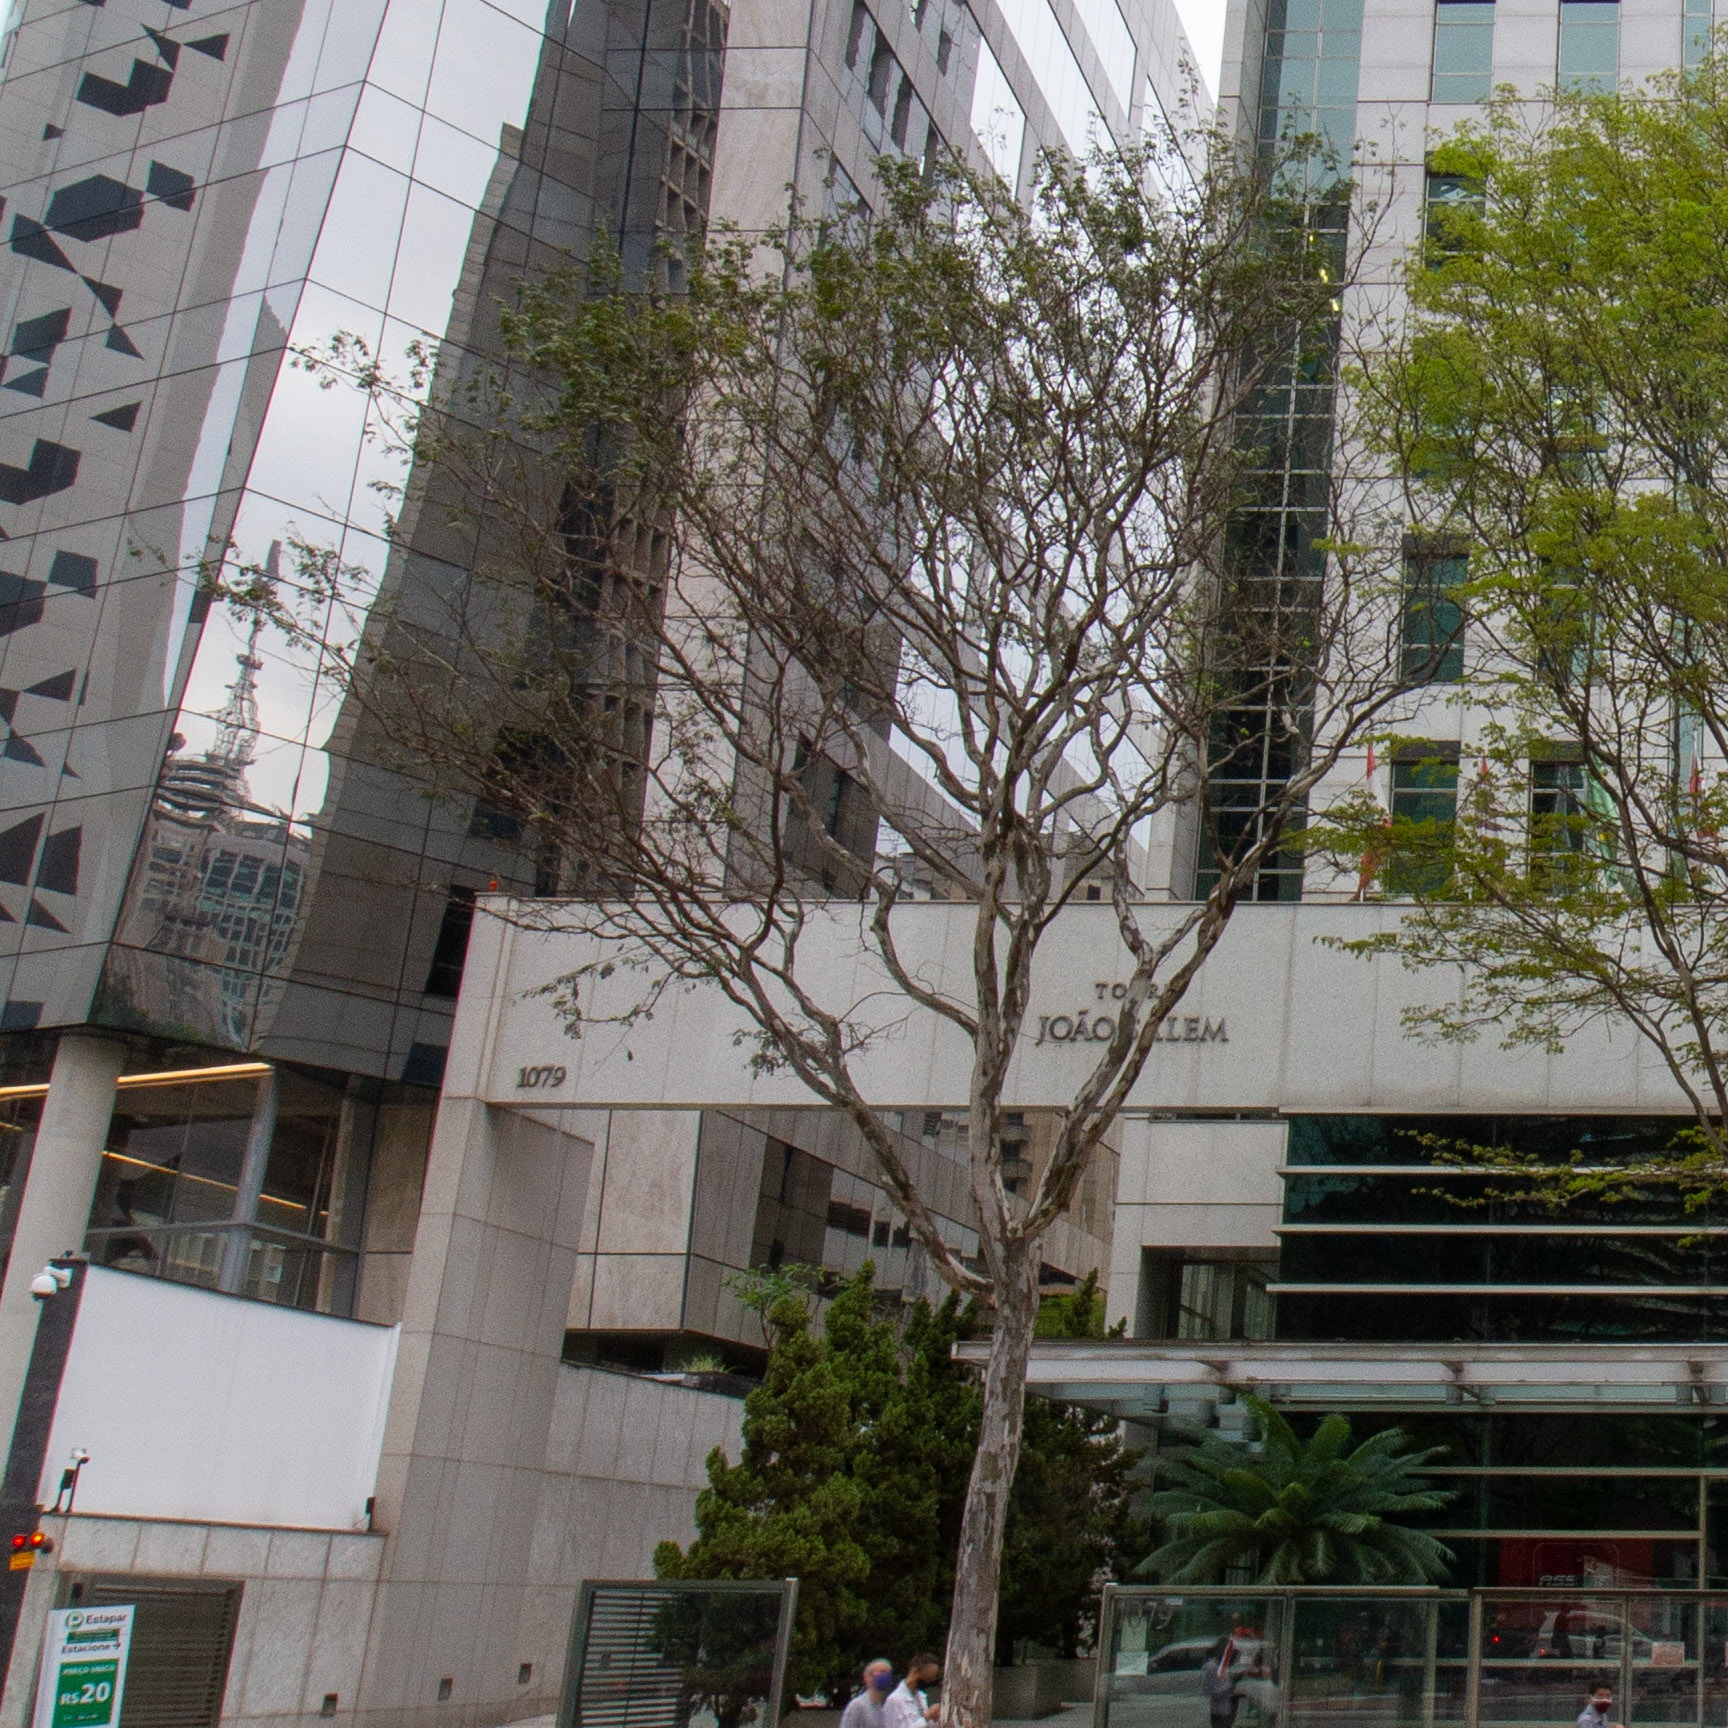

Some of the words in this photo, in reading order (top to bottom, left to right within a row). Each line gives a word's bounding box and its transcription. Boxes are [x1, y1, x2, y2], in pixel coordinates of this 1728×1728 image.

[1094, 982, 1173, 1000] TOR
[1035, 1008, 1116, 1047] JOÃO
[1131, 1016, 1229, 1043] LEM
[516, 1065, 568, 1089] 1079
[86, 1613, 127, 1626] Estapar
